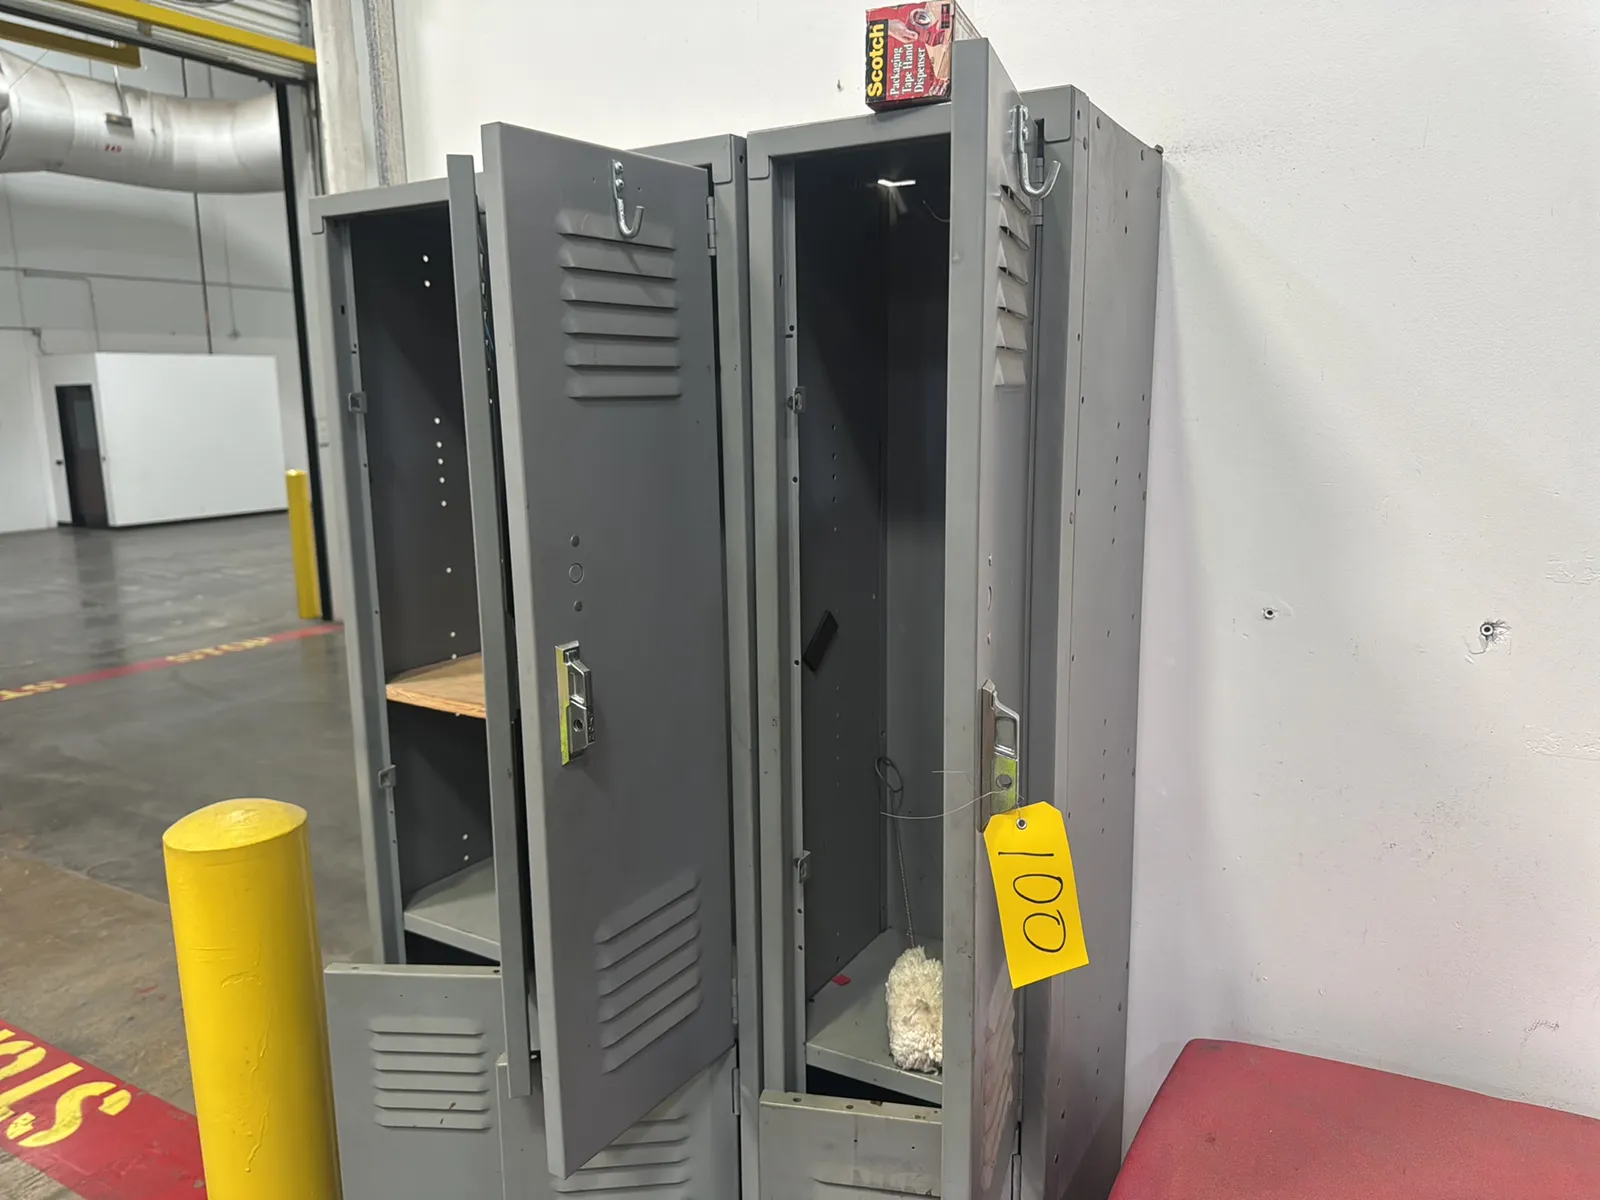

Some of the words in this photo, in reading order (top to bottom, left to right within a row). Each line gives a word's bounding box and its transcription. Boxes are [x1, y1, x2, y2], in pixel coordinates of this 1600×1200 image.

[867, 23, 884, 97] Scotch
[890, 47, 903, 96] Packaging
[902, 43, 914, 70] Hand
[914, 47, 926, 93] Dispenser
[902, 71, 914, 94] Tape
